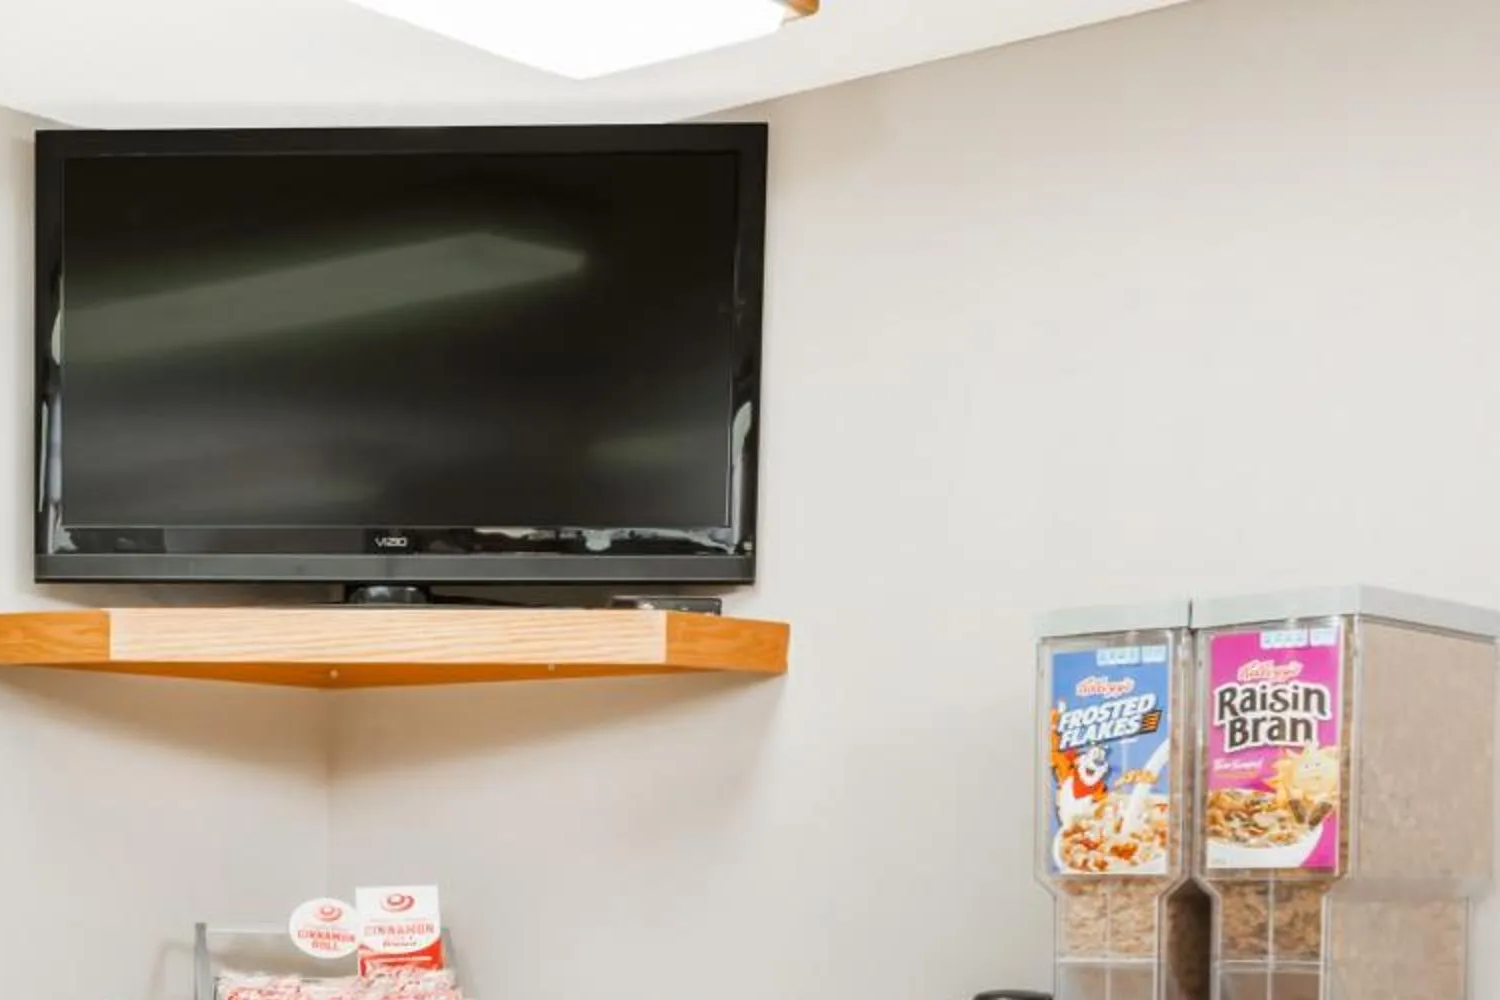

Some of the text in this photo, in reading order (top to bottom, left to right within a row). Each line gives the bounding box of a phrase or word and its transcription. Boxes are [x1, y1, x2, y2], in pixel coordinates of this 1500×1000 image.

[1058, 693, 1157, 731] FROSTED
[1218, 684, 1328, 722] Raisin
[1060, 716, 1141, 749] FLAKES
[1228, 716, 1312, 748] Bran
